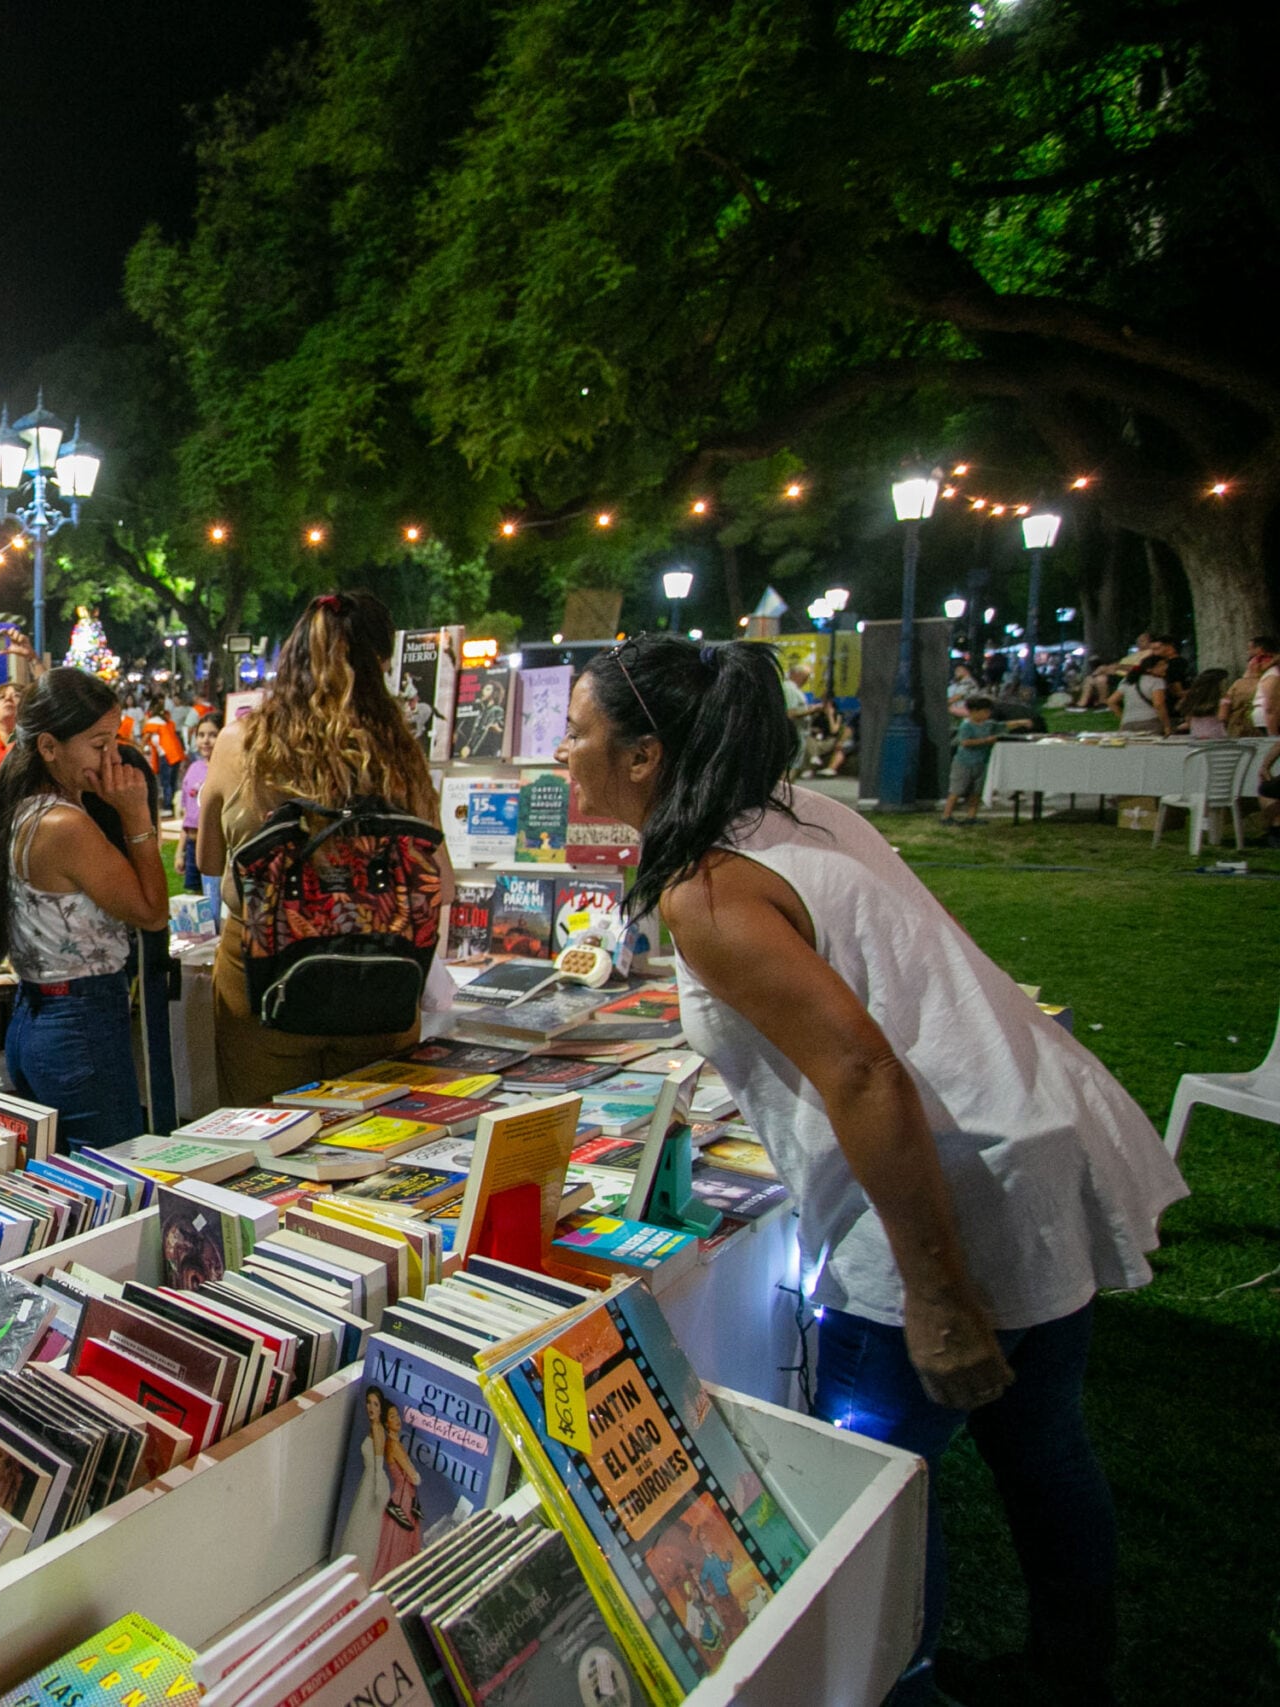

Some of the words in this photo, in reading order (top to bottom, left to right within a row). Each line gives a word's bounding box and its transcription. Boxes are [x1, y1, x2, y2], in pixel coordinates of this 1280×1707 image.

[403, 650, 437, 663] FIERRO
[406, 642, 435, 652] Martín
[503, 892, 529, 905] PARA
[510, 880, 525, 893] DE
[556, 888, 617, 913] MAUS
[374, 1349, 413, 1396] Mi
[418, 1383, 493, 1438] gran
[587, 1379, 642, 1440] TINTIN
[399, 1427, 481, 1494] debut
[601, 1446, 628, 1482] EL
[619, 1417, 662, 1467] LAGO
[618, 1448, 689, 1522] TIBURONES
[40, 1675, 84, 1707] LAS
